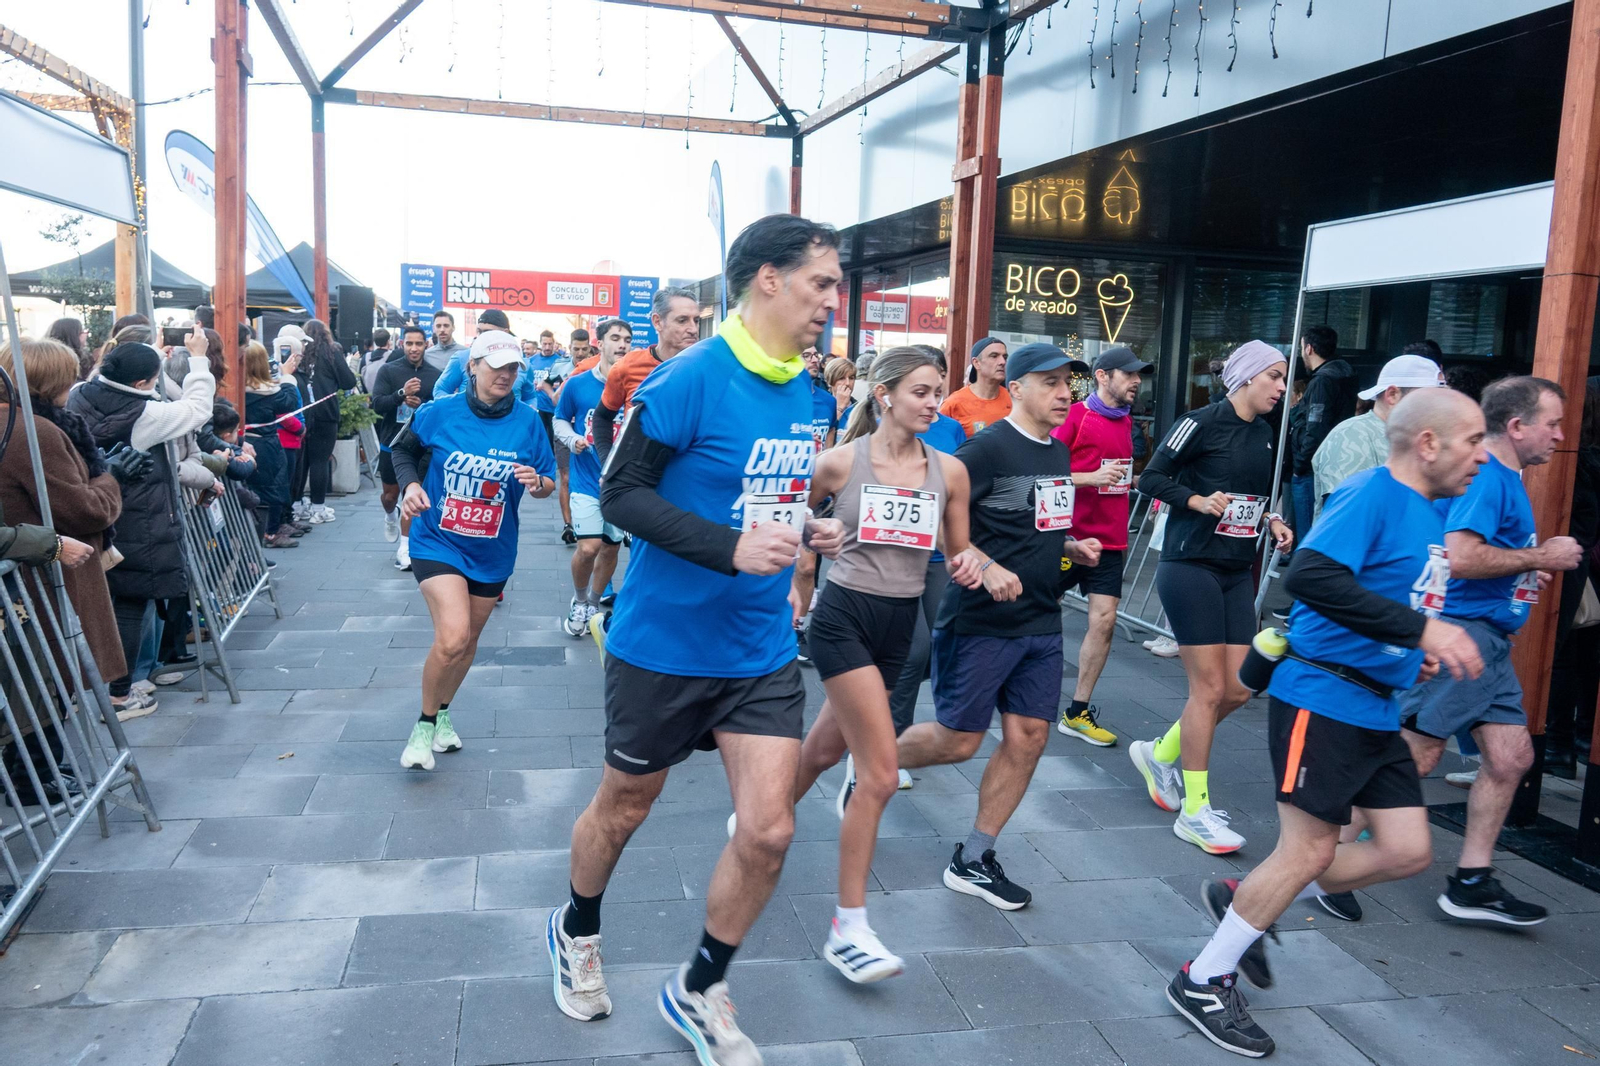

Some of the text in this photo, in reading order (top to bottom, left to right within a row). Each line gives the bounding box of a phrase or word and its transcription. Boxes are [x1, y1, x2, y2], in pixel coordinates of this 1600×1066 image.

[447, 270, 490, 288] RUN
[1006, 263, 1081, 298] BICO
[551, 286, 589, 295] CONCELLO
[1005, 294, 1077, 315] de xeado
[1054, 491, 1068, 508] 45
[461, 506, 493, 523] 828
[883, 500, 920, 524] 375
[1236, 505, 1255, 520] 336
[453, 524, 486, 535] Alcampo
